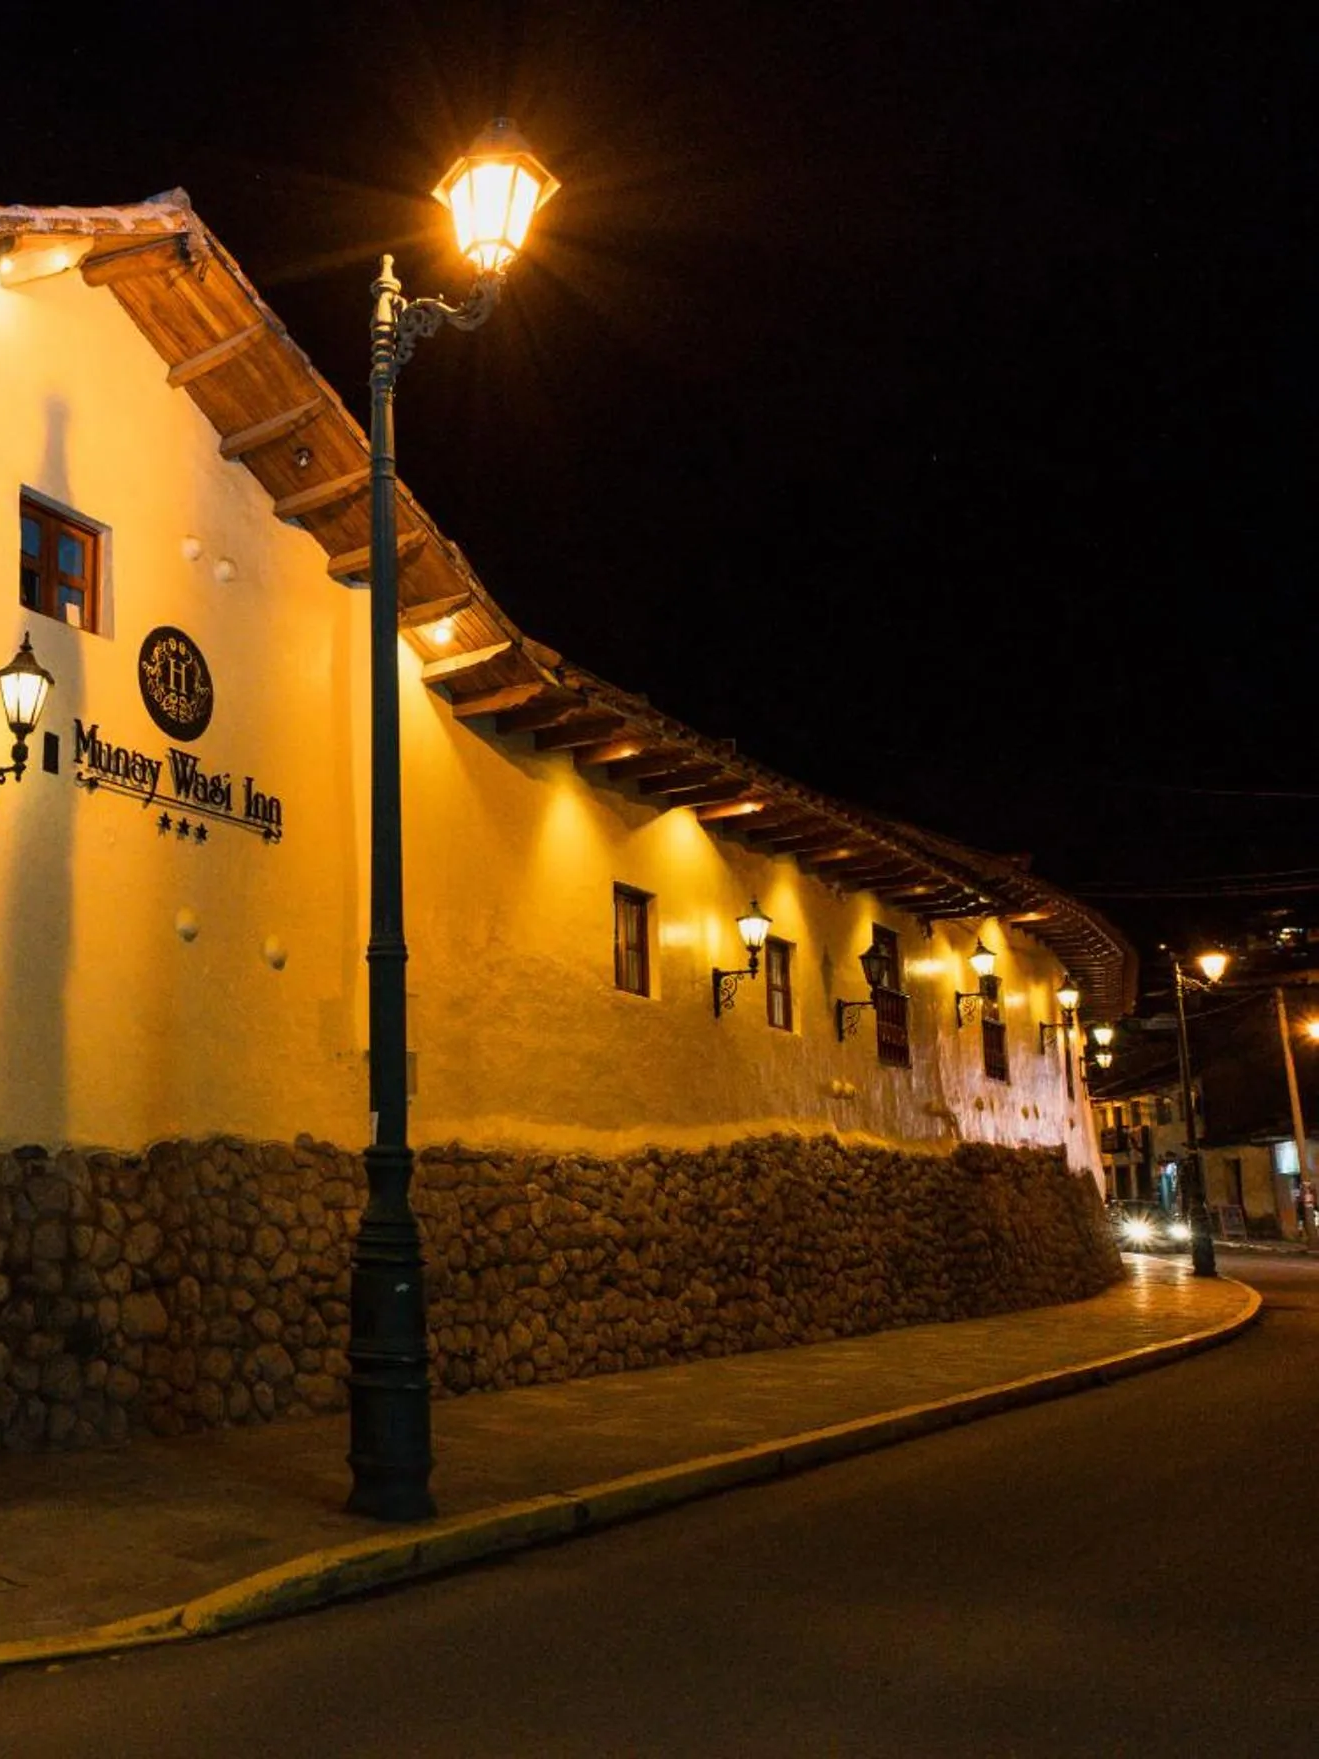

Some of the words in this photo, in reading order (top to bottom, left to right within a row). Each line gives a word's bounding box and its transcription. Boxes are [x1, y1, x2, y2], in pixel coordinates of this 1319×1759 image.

[169, 658, 187, 695] H
[74, 718, 162, 801] Munay
[169, 747, 232, 811] Wasi
[243, 776, 281, 826] Inn
